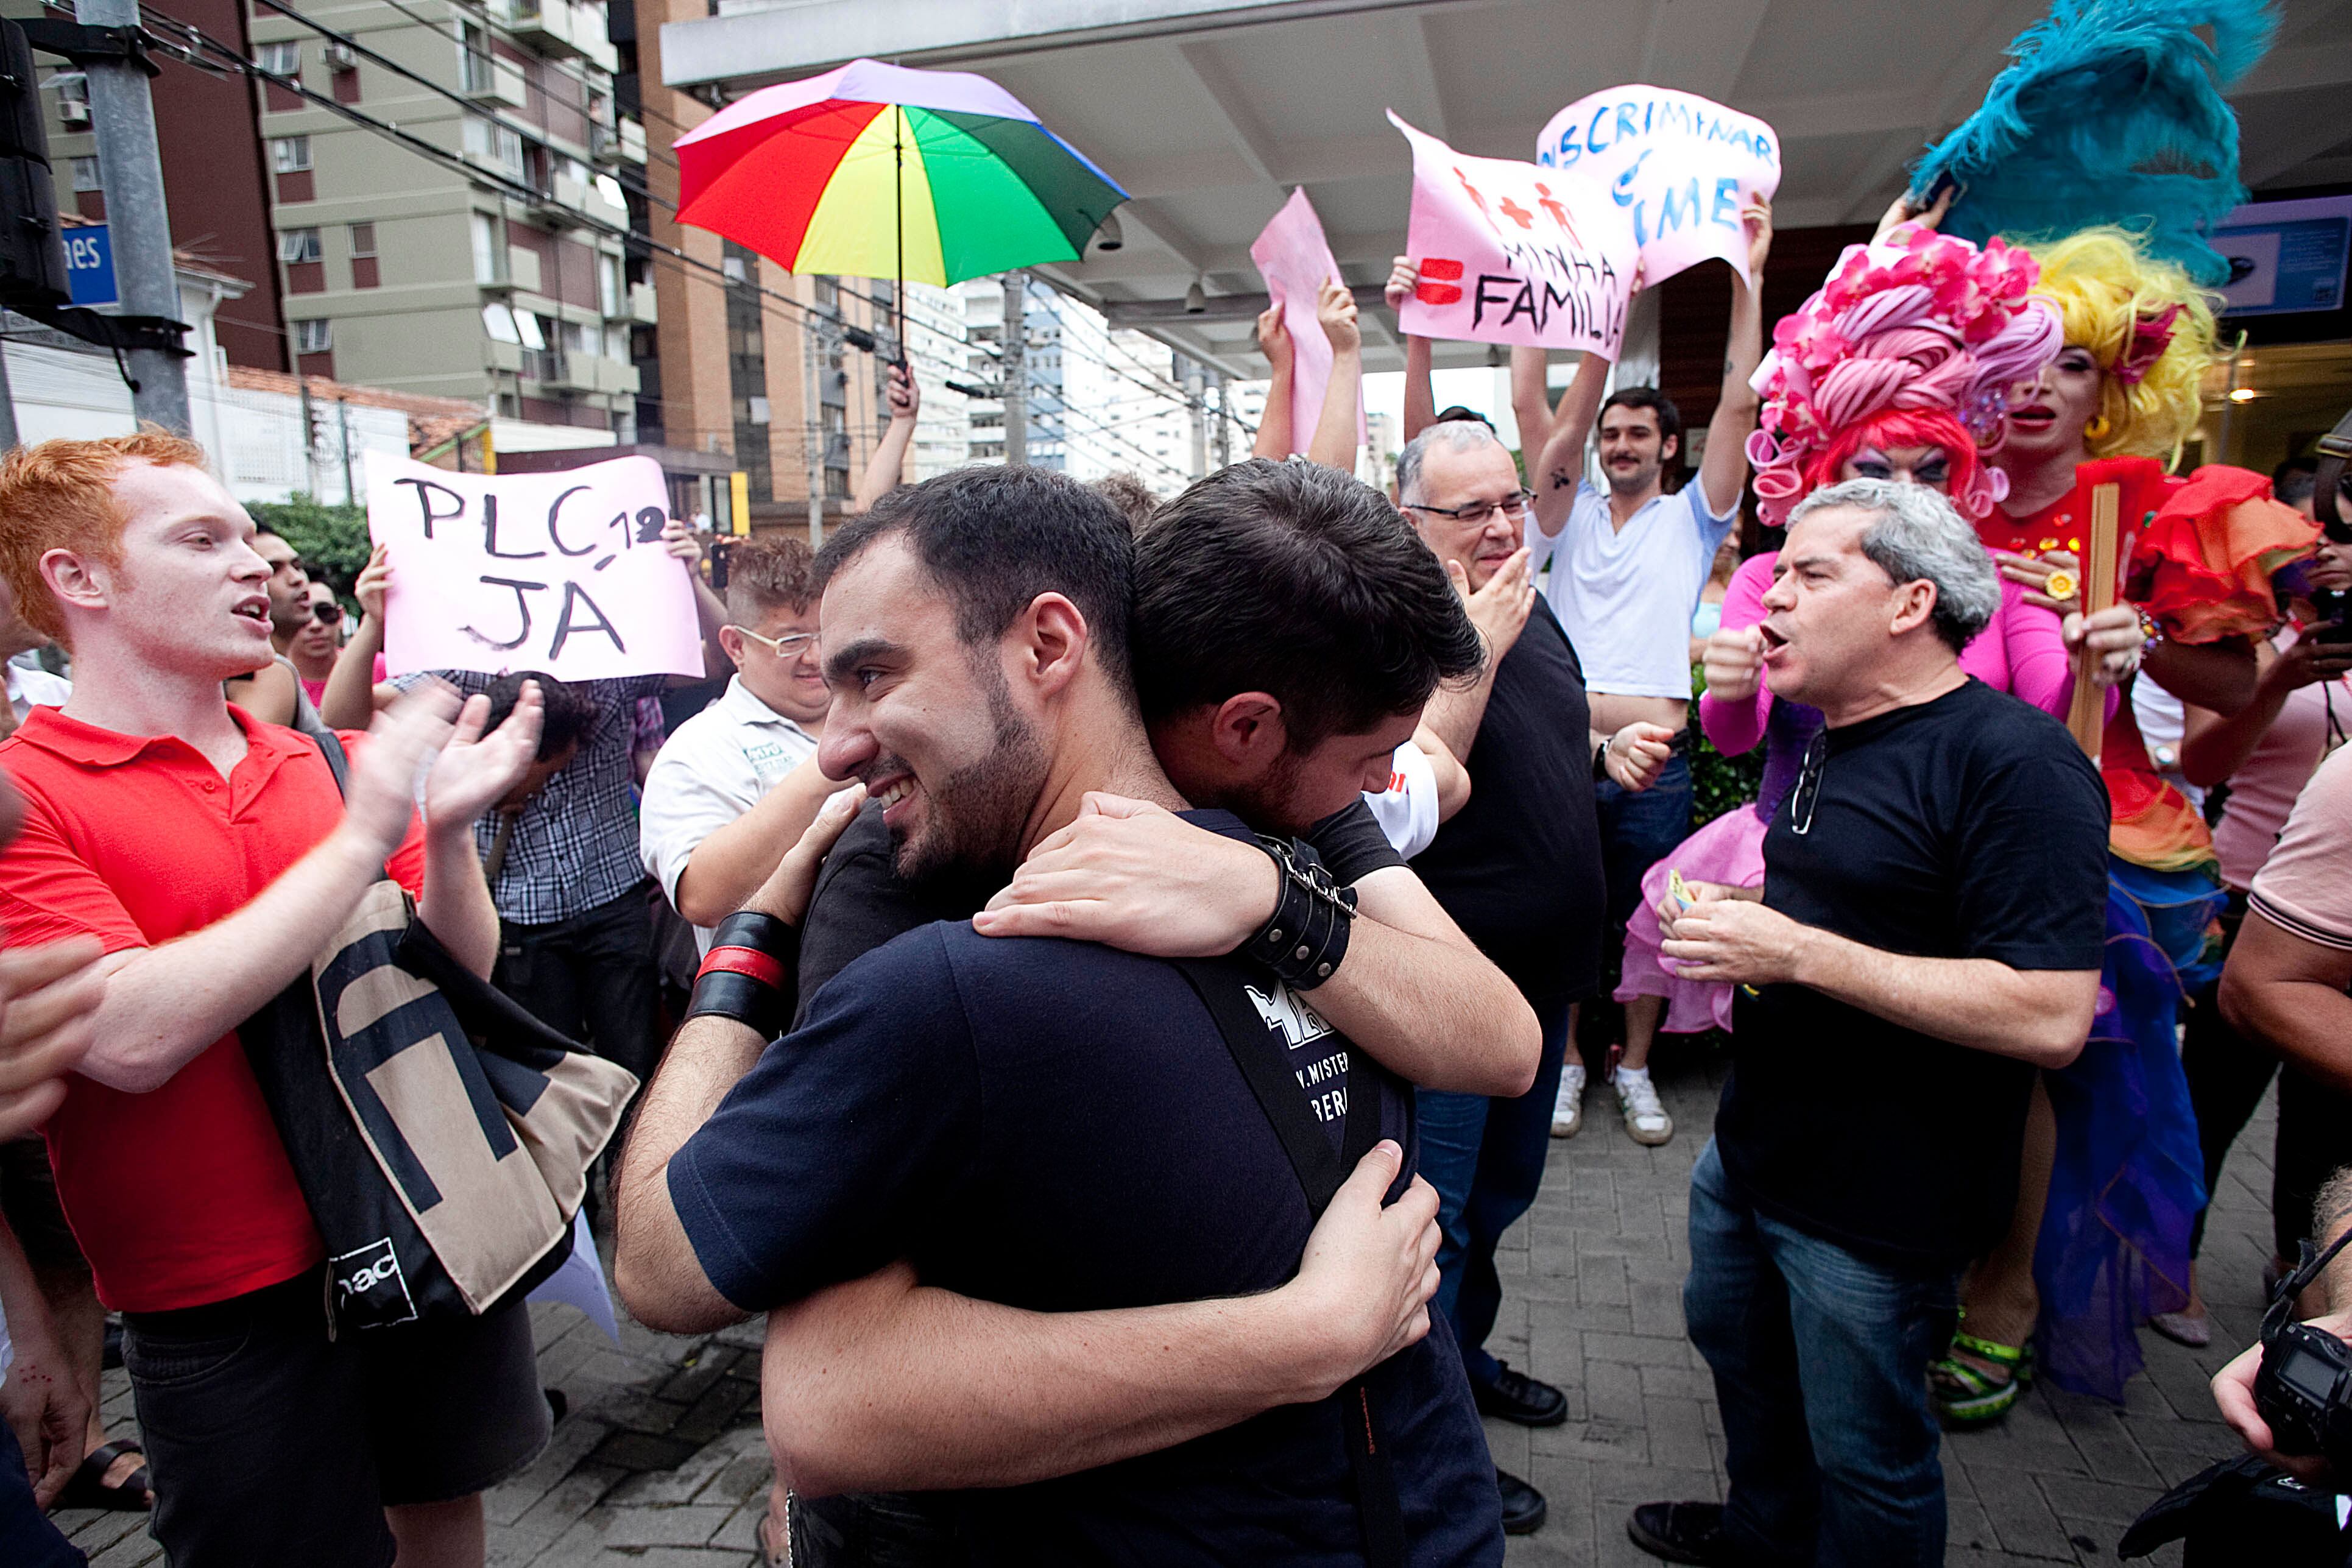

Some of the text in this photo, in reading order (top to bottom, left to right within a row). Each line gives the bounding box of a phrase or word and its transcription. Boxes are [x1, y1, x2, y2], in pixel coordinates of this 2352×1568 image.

[1501, 241, 1617, 296] MINHA
[394, 478, 597, 556] PLC
[458, 554, 626, 661] JÁ
